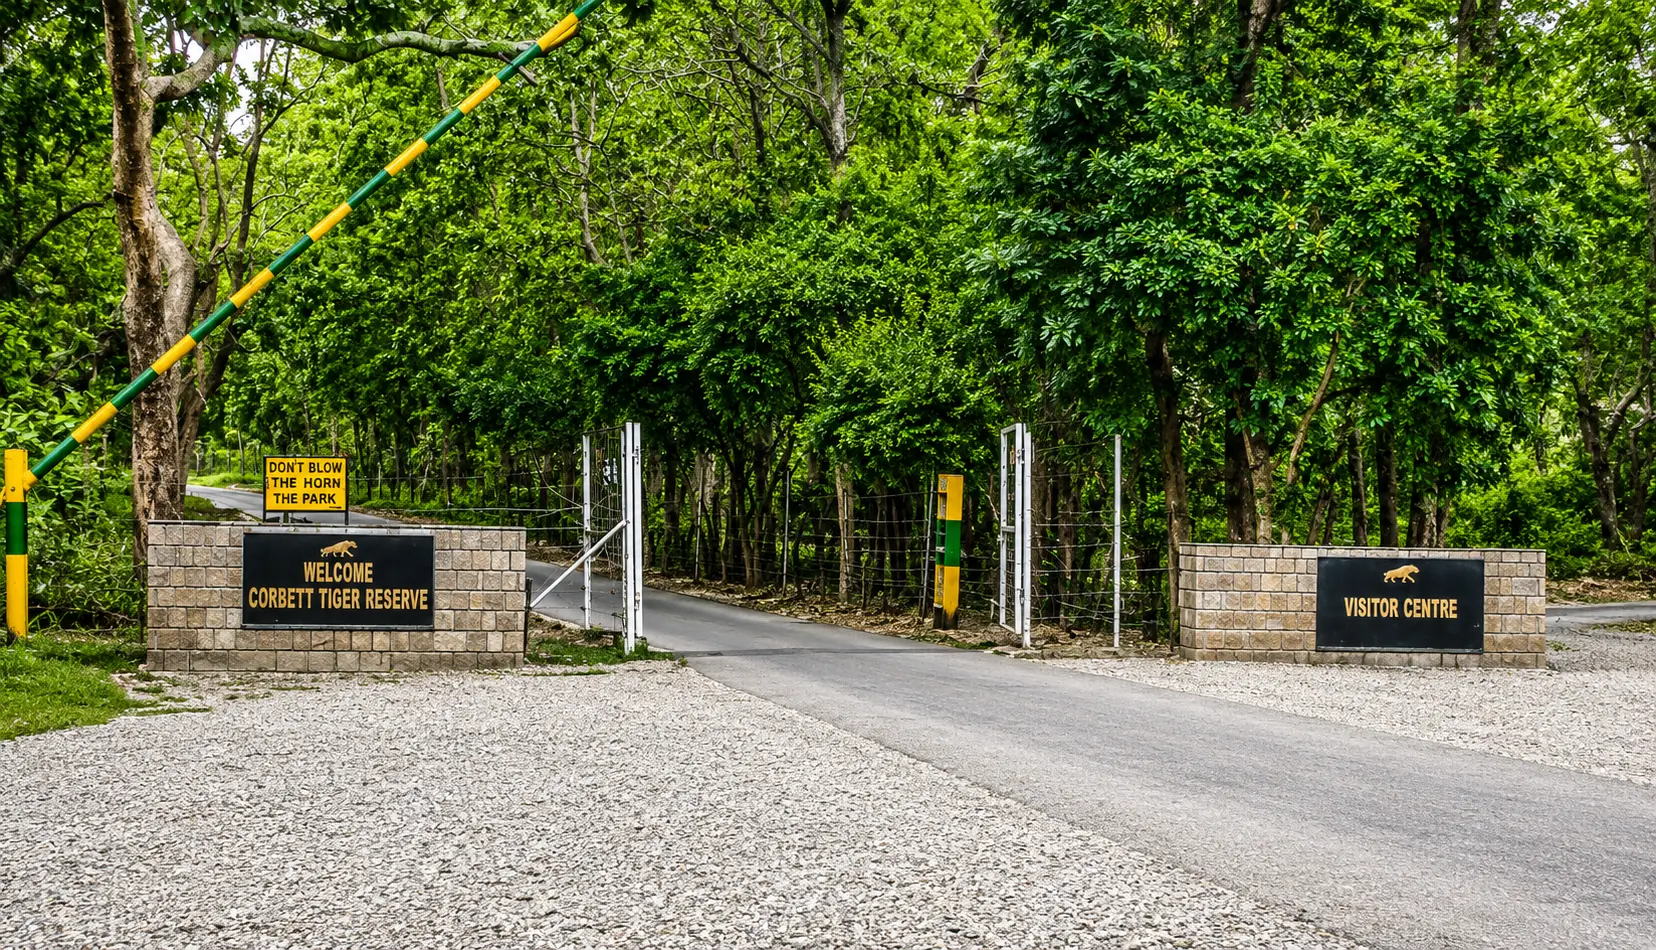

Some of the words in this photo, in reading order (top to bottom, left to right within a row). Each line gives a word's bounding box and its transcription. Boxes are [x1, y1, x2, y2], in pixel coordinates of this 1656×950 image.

[269, 460, 304, 473] DON'T
[309, 462, 342, 473] BLOW
[271, 477, 297, 488] THE
[304, 477, 340, 488] HORN
[273, 493, 298, 504] THE
[303, 493, 336, 504] PARK
[303, 561, 373, 583] WELCOME
[249, 587, 314, 609] CORBETT
[318, 588, 360, 609] TIGER
[365, 588, 428, 610] RESERVE
[1344, 597, 1399, 618] VISITOR
[1404, 598, 1458, 619] CENTRE
